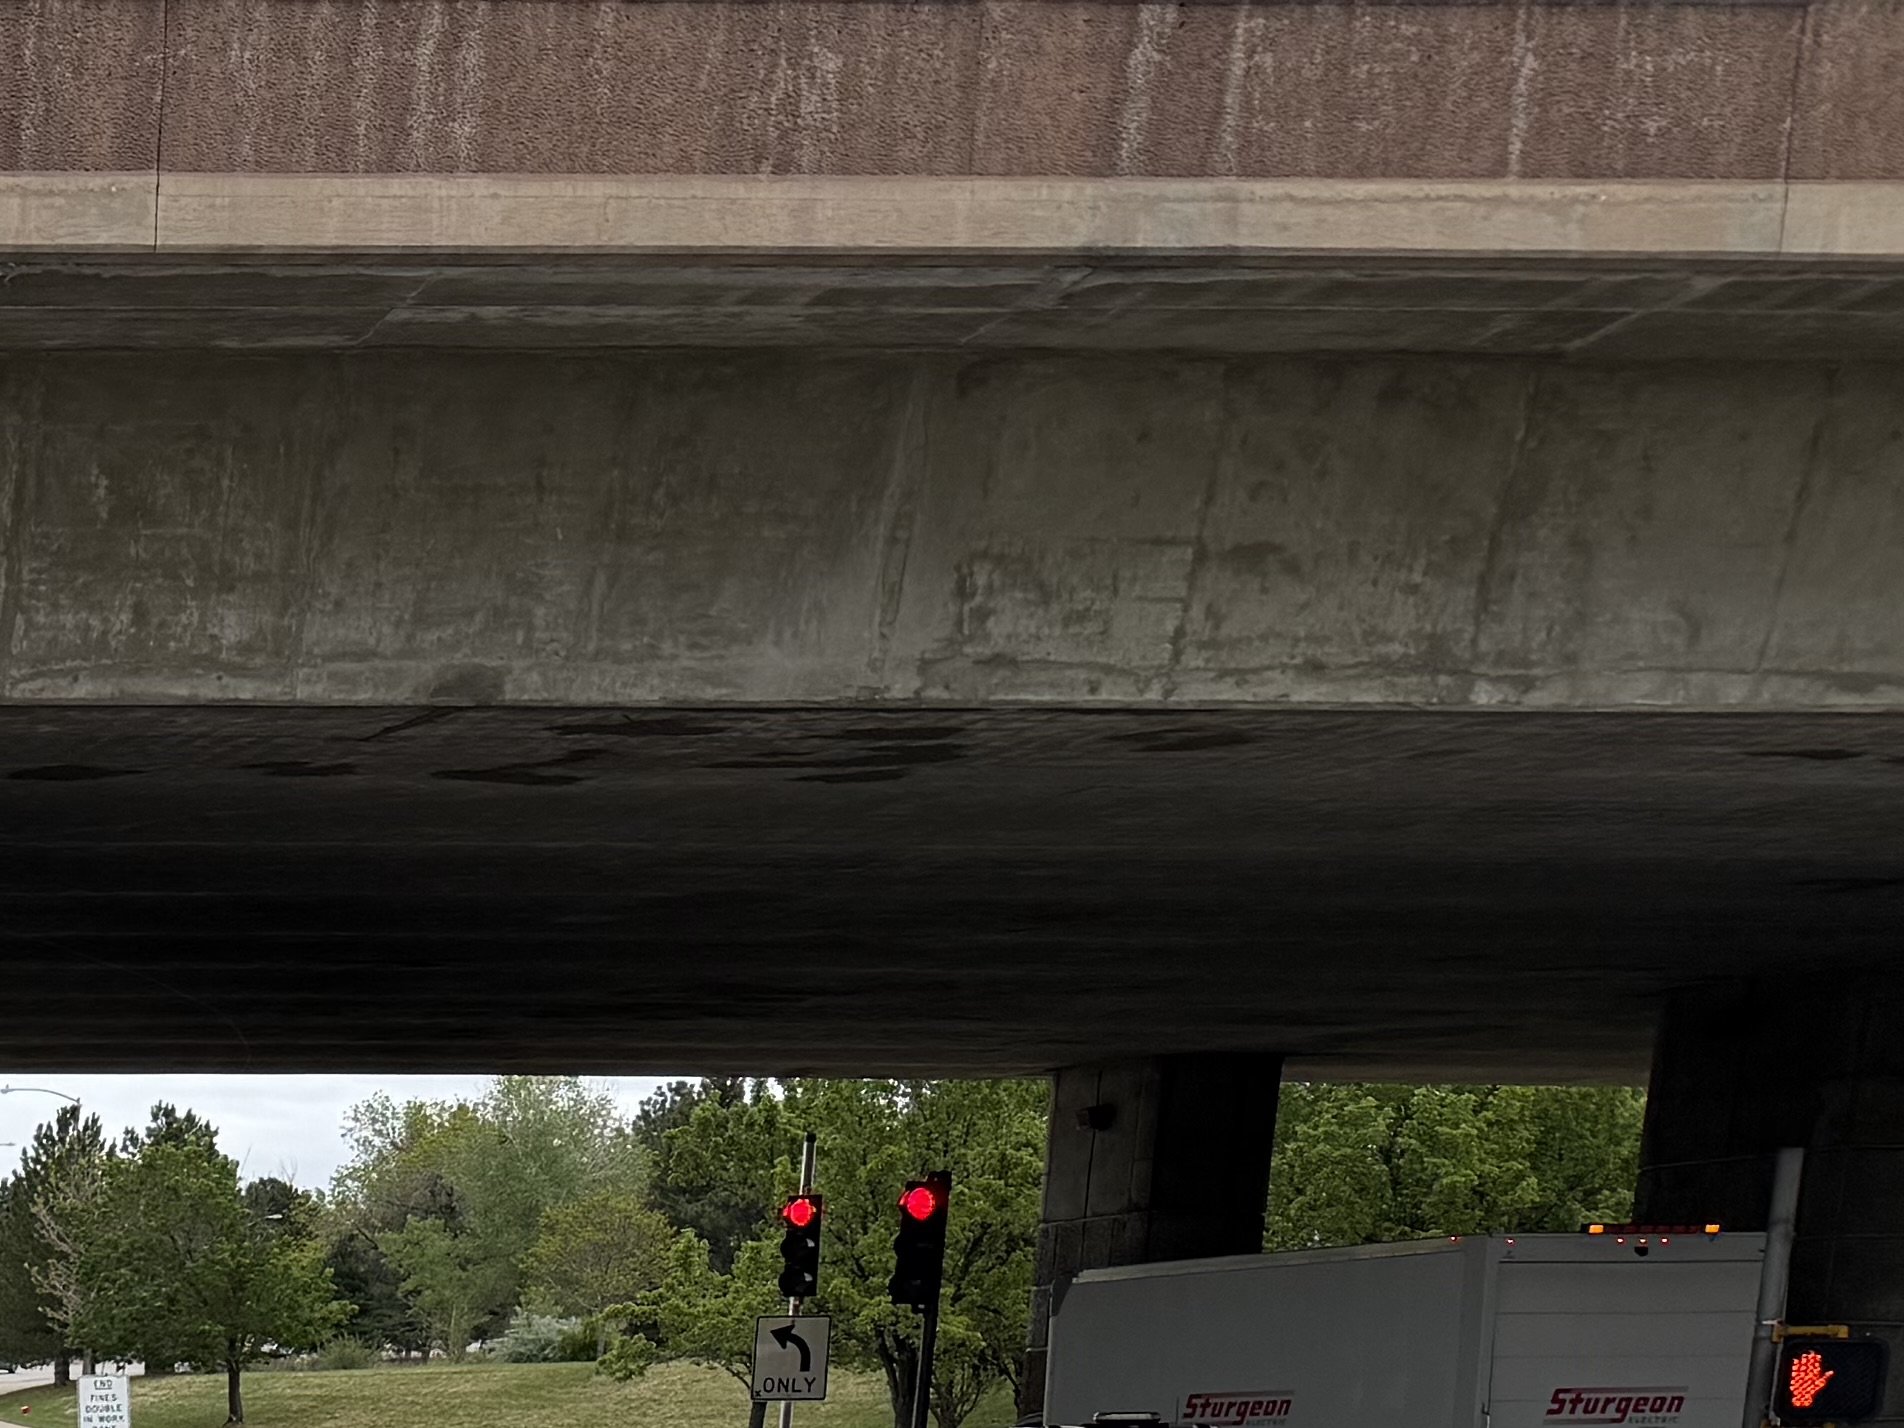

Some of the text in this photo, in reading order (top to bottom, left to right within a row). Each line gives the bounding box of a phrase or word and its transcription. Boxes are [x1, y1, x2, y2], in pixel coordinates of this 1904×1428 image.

[763, 1377, 816, 1393] ONLY
[1183, 1393, 1292, 1426] Sturgeon
[1545, 1388, 1685, 1424] Sturgeon
